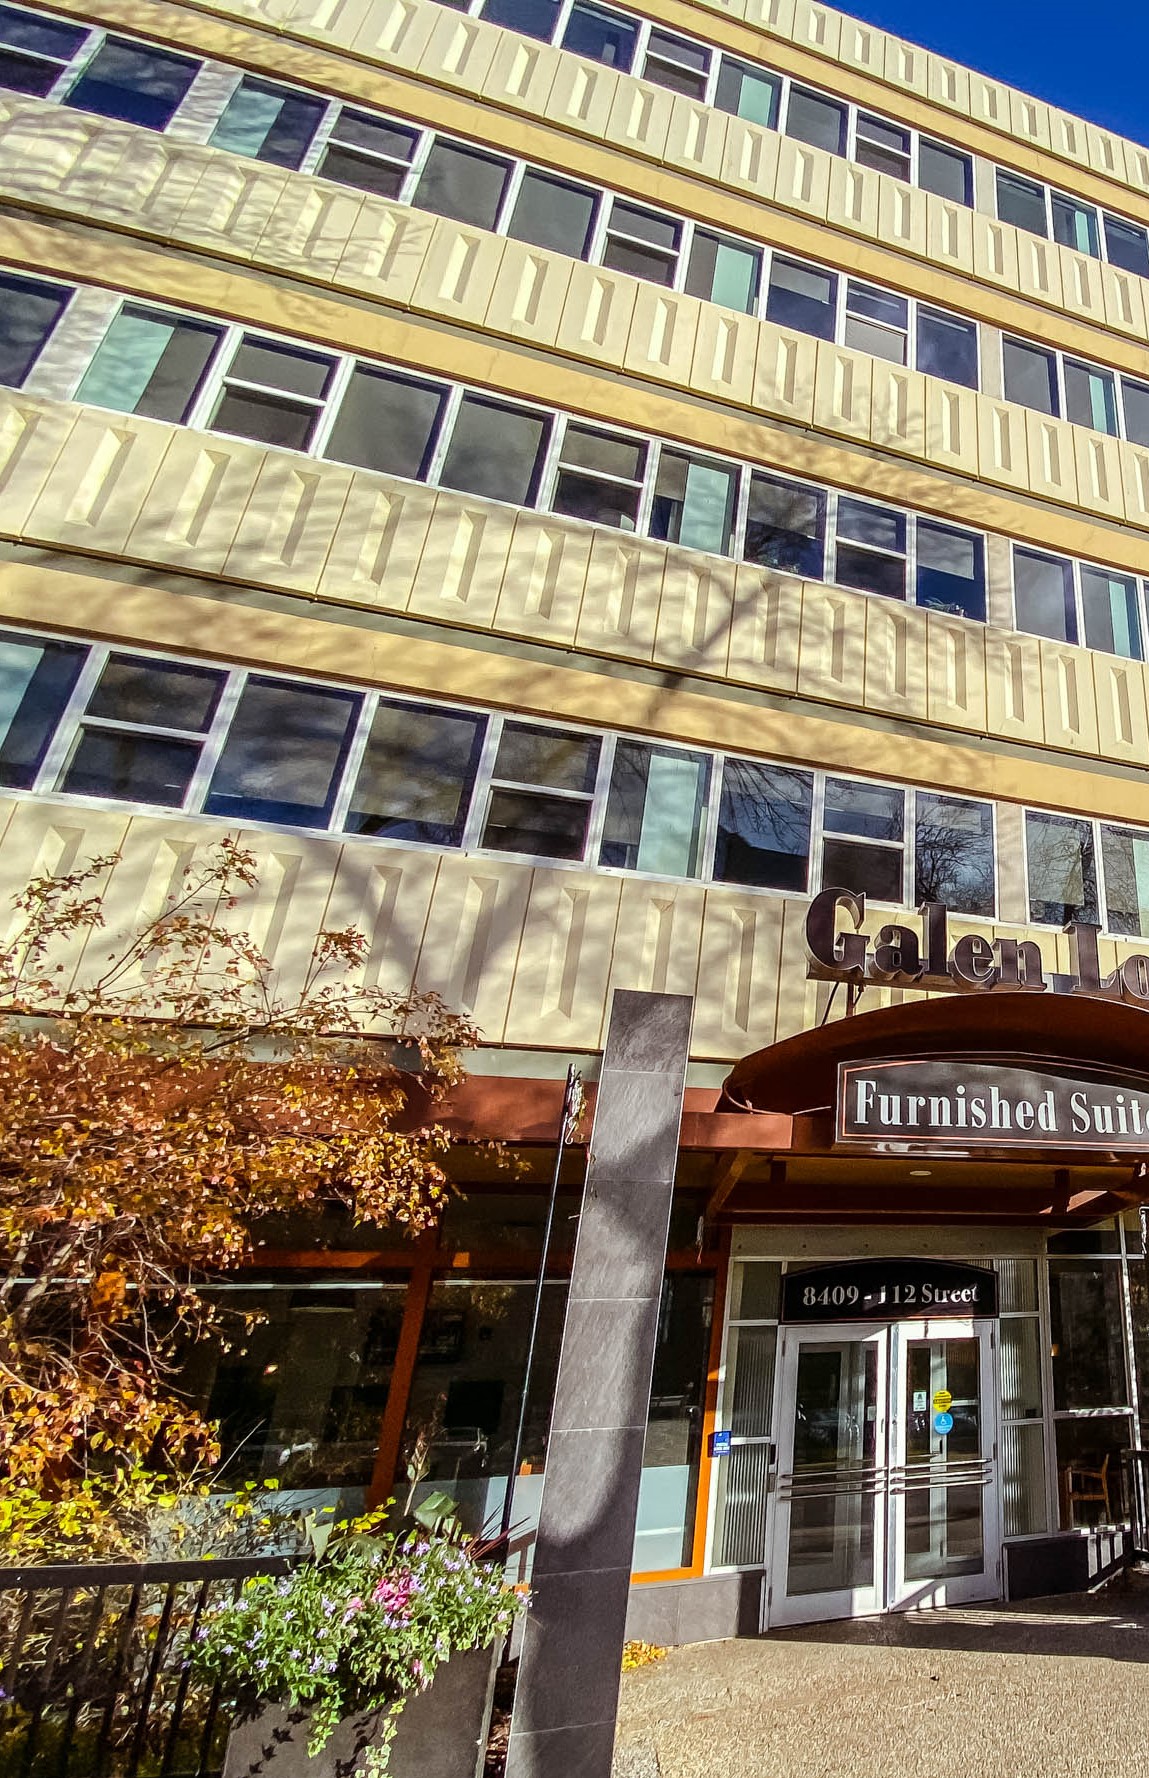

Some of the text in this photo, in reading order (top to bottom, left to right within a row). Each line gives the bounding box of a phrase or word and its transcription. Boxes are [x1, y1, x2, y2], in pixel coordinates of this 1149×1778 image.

[805, 887, 1047, 992] Galen
[854, 1079, 1059, 1132] Furnished
[803, 1285, 859, 1305] 8409
[878, 1285, 916, 1304] 112
[921, 1283, 980, 1304] Street
